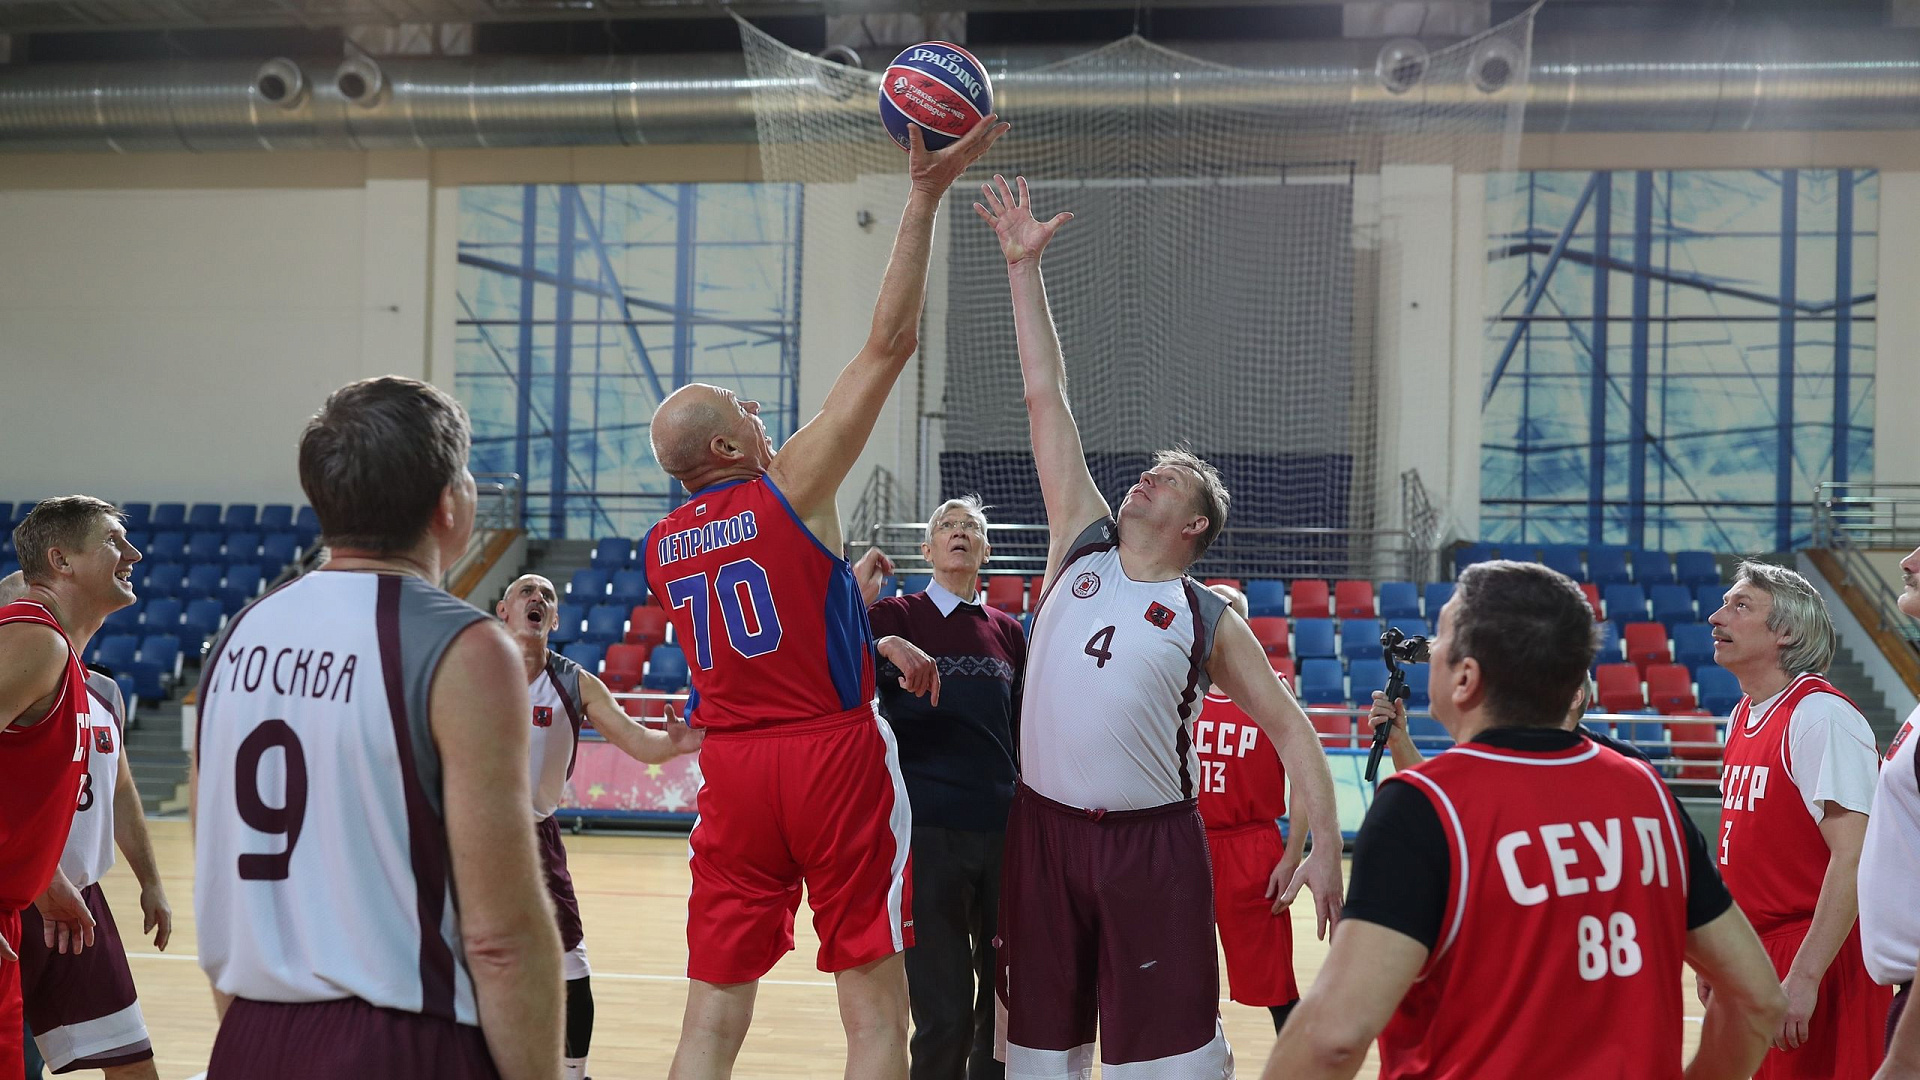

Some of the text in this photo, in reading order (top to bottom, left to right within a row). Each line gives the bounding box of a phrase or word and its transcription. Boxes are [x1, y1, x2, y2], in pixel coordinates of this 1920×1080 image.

[908, 48, 983, 101] SPALDING
[908, 84, 938, 104] TURKISH
[658, 510, 758, 567] ПЕТРАКОВ
[665, 557, 783, 671] 70
[213, 645, 358, 704] МОСКВА
[1084, 625, 1116, 669] 4
[235, 719, 308, 881] 9
[1201, 760, 1226, 793] 13
[1496, 816, 1669, 906] СЕУЛ
[1577, 911, 1643, 981] 88
